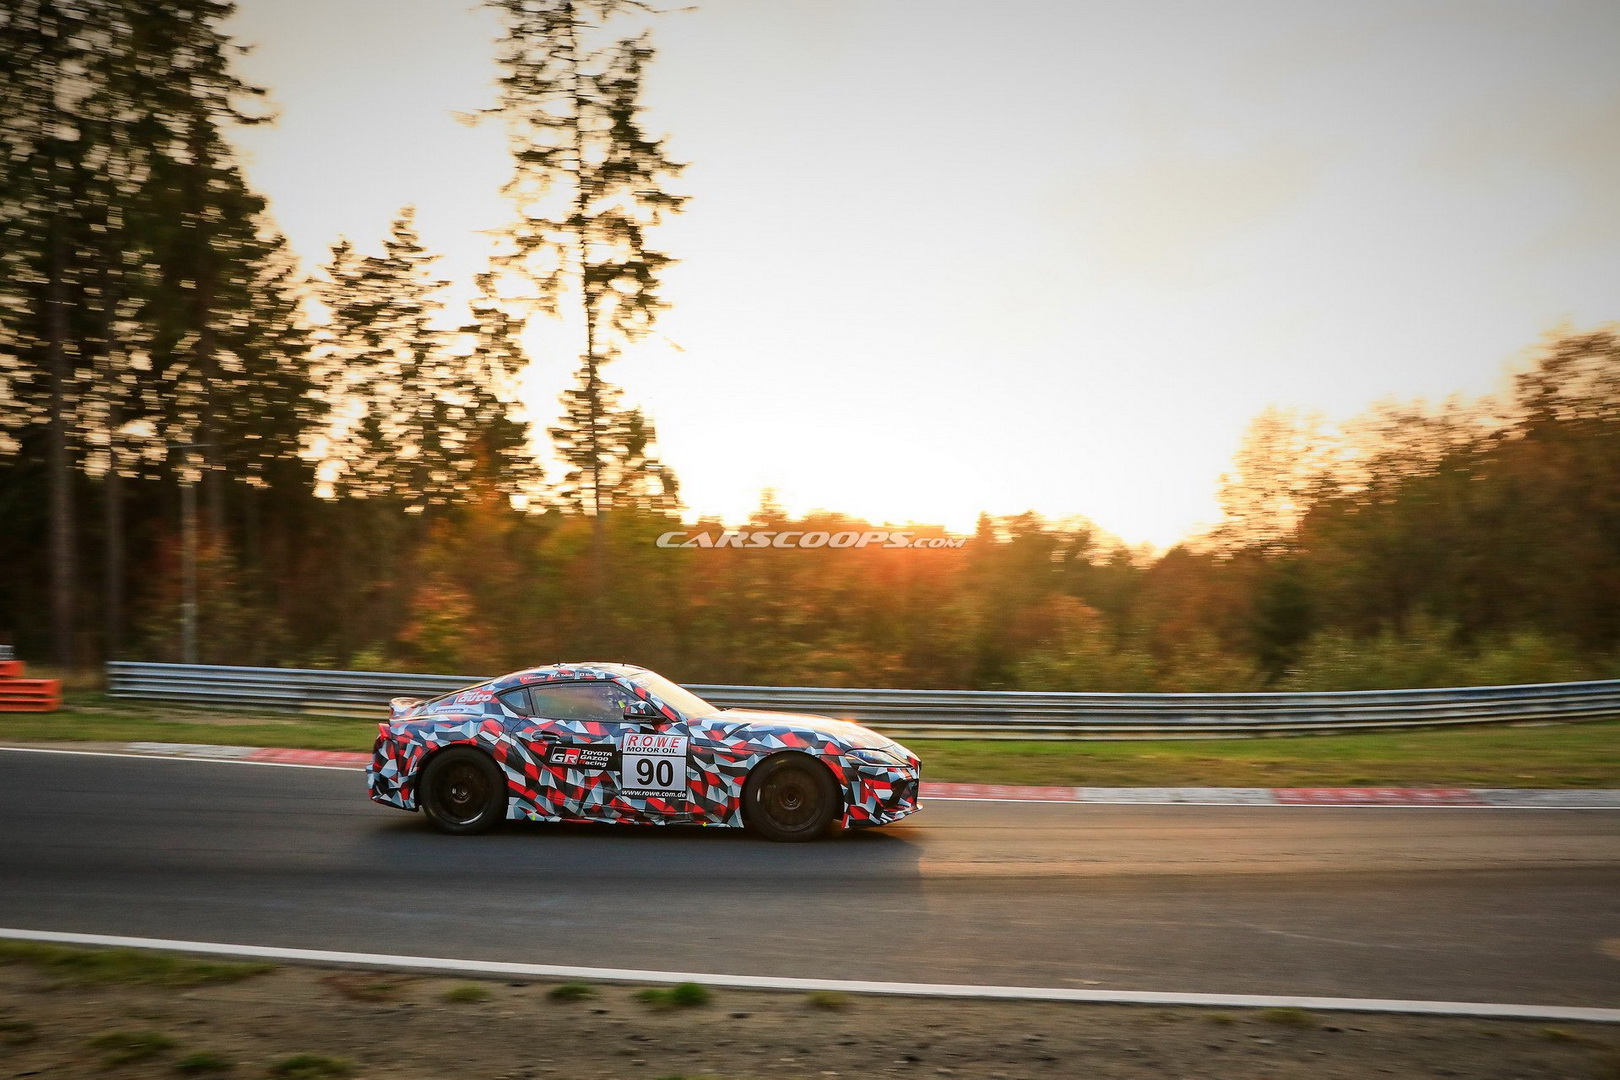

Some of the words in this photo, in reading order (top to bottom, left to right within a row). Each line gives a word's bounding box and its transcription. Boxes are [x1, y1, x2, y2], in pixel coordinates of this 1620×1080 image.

[458, 694, 493, 703] auto
[626, 735, 682, 748] ROWE
[551, 753, 578, 765] GR
[579, 760, 607, 768] Racing
[636, 758, 674, 787] 90
[621, 790, 687, 798] www.rowe.com.de
